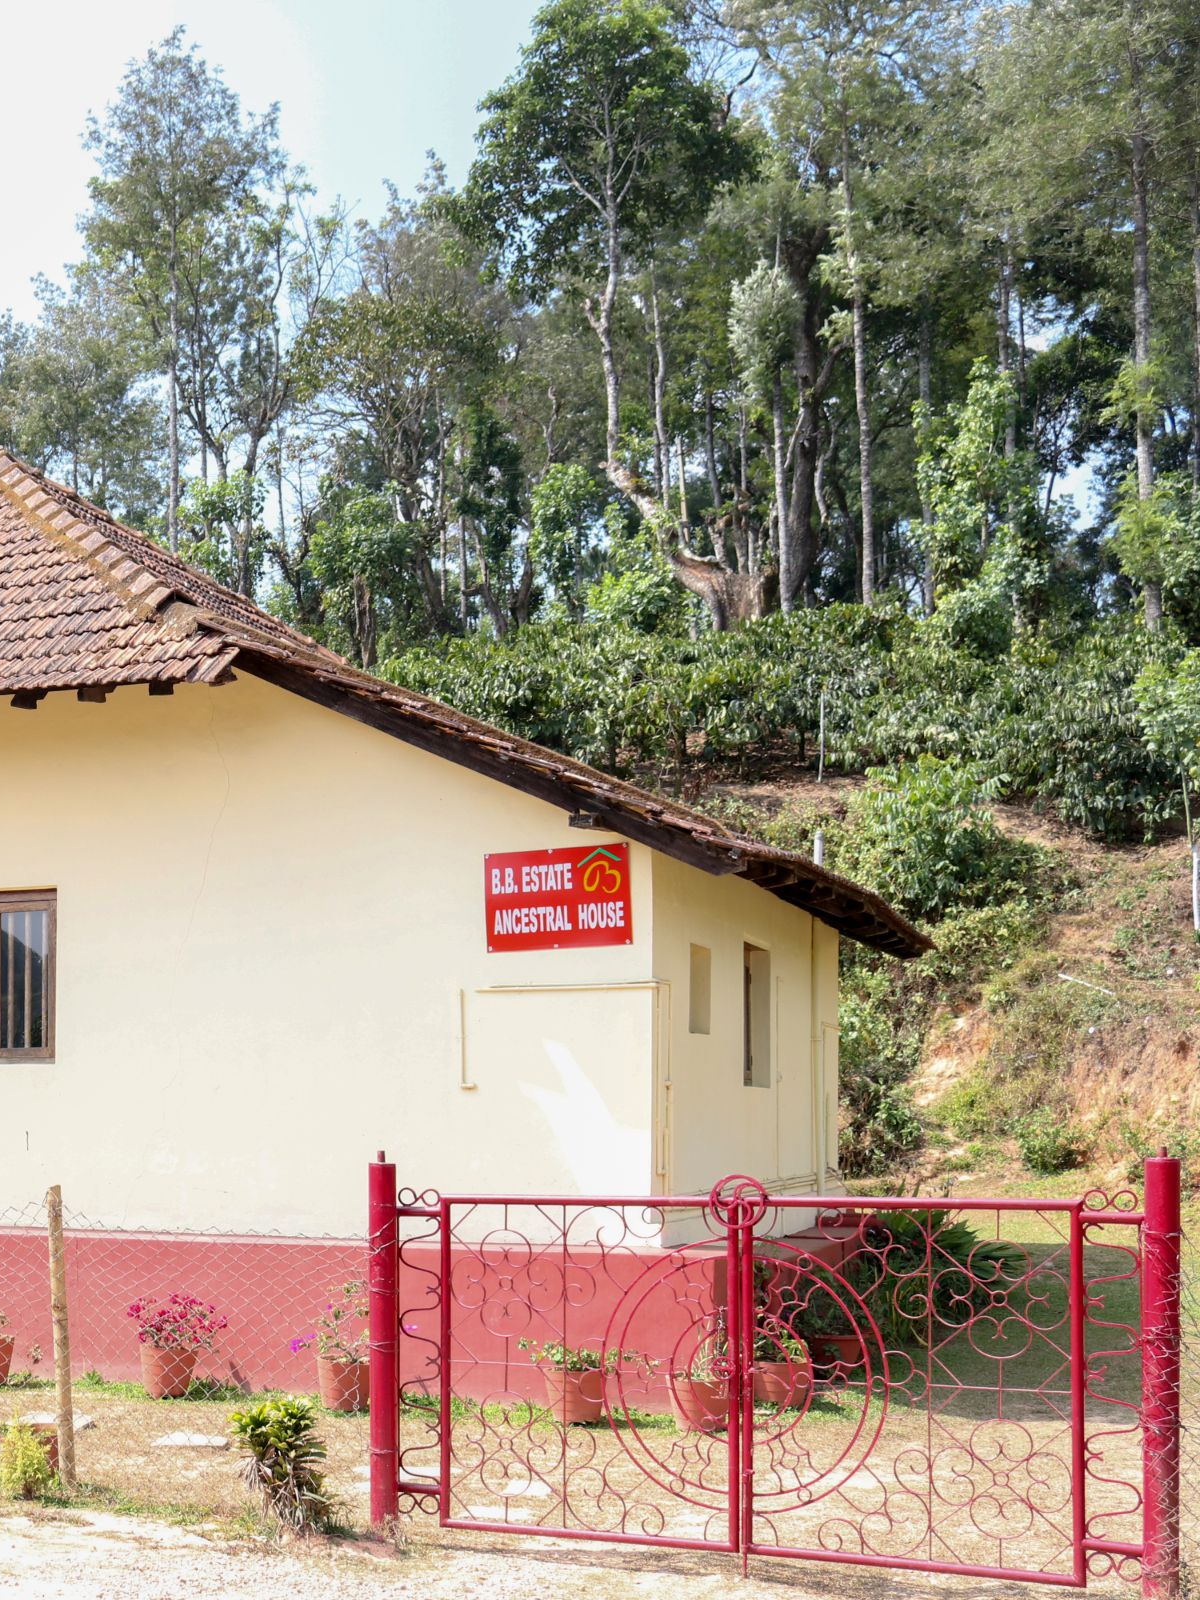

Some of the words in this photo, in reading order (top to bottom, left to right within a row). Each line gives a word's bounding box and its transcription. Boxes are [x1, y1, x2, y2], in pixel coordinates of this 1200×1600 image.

[491, 867, 518, 895] B.B.
[521, 863, 573, 893] ESTATE
[494, 905, 572, 935] ANCESTRAL
[578, 901, 625, 930] HOUSE
